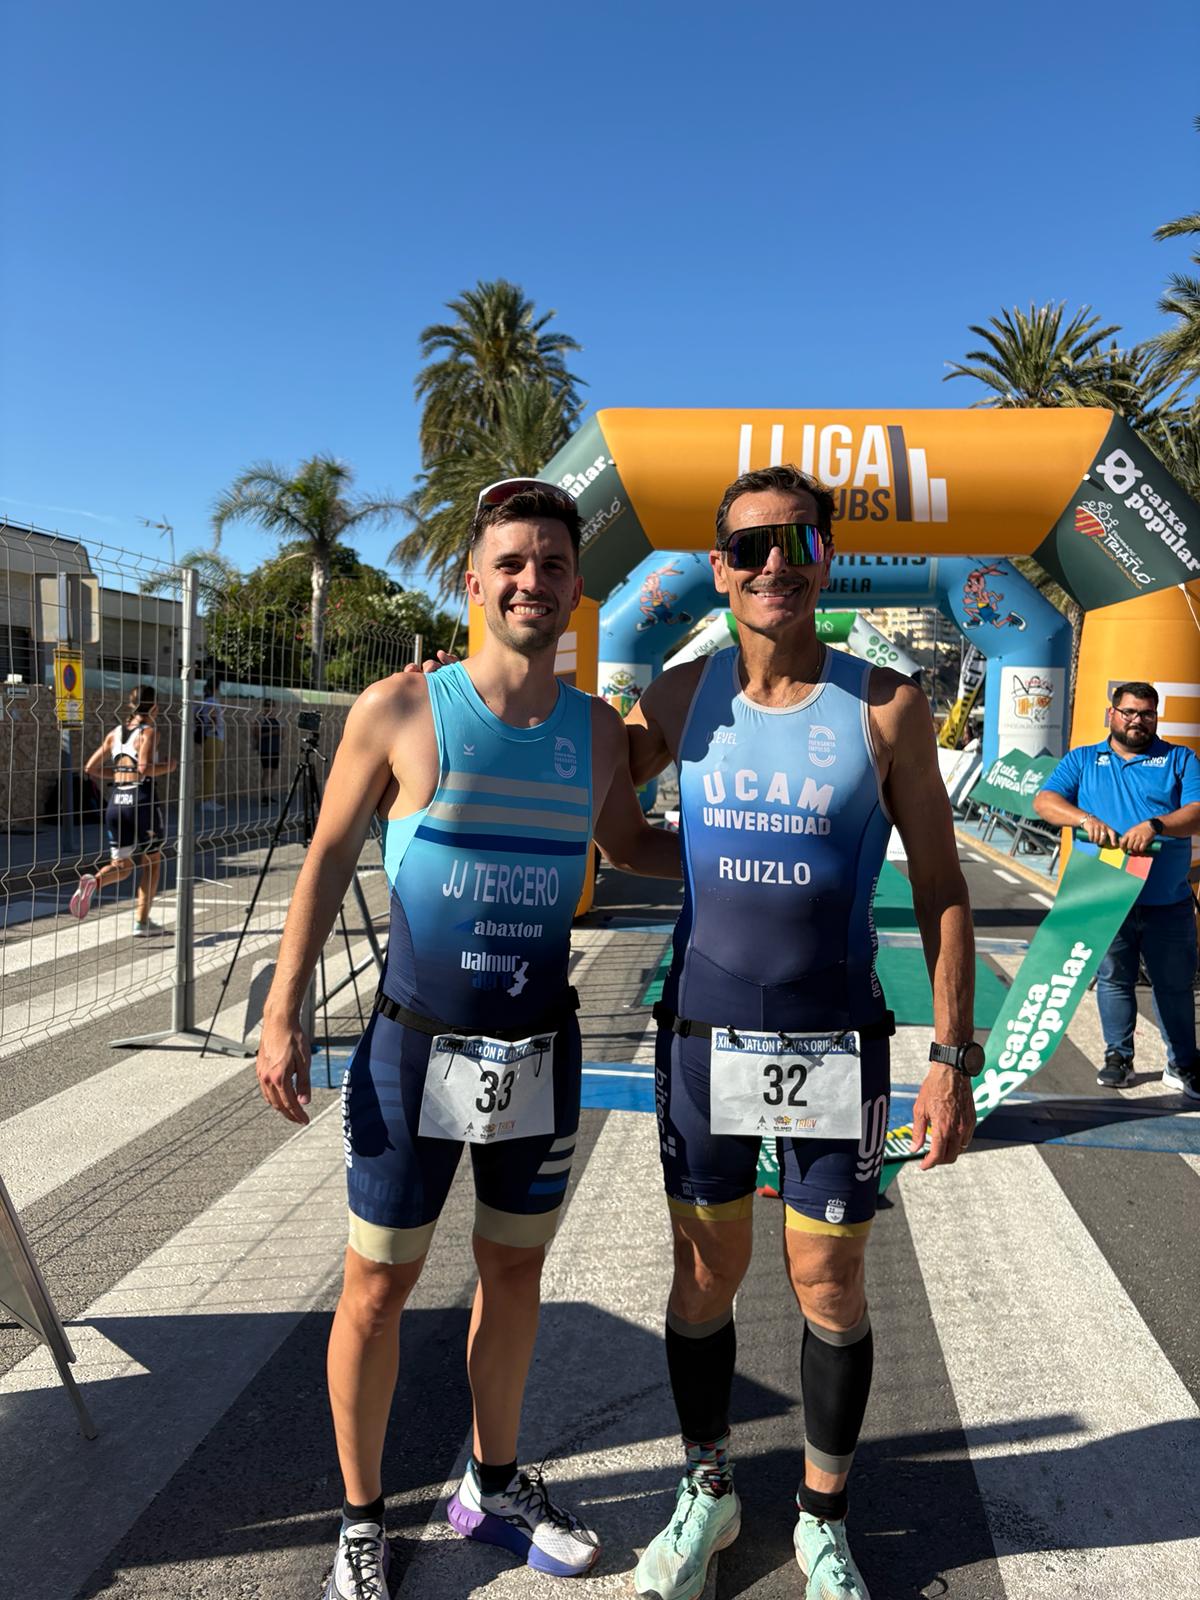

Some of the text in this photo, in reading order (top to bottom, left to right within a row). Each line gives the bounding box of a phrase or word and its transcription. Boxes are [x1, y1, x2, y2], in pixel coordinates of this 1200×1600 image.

[831, 489, 890, 522] UBS
[1140, 483, 1187, 536] caixa
[1124, 492, 1200, 571] popular
[703, 769, 834, 816] UCAM
[703, 807, 831, 836] UNIVERSIDAD
[442, 860, 559, 906] JJ TERCERO
[719, 856, 811, 885] RUIZLO
[474, 920, 543, 938] abaxton
[998, 983, 1049, 1070] caixa
[1017, 941, 1093, 1071] popular
[475, 1070, 515, 1114] 33
[763, 1064, 808, 1107] 32
